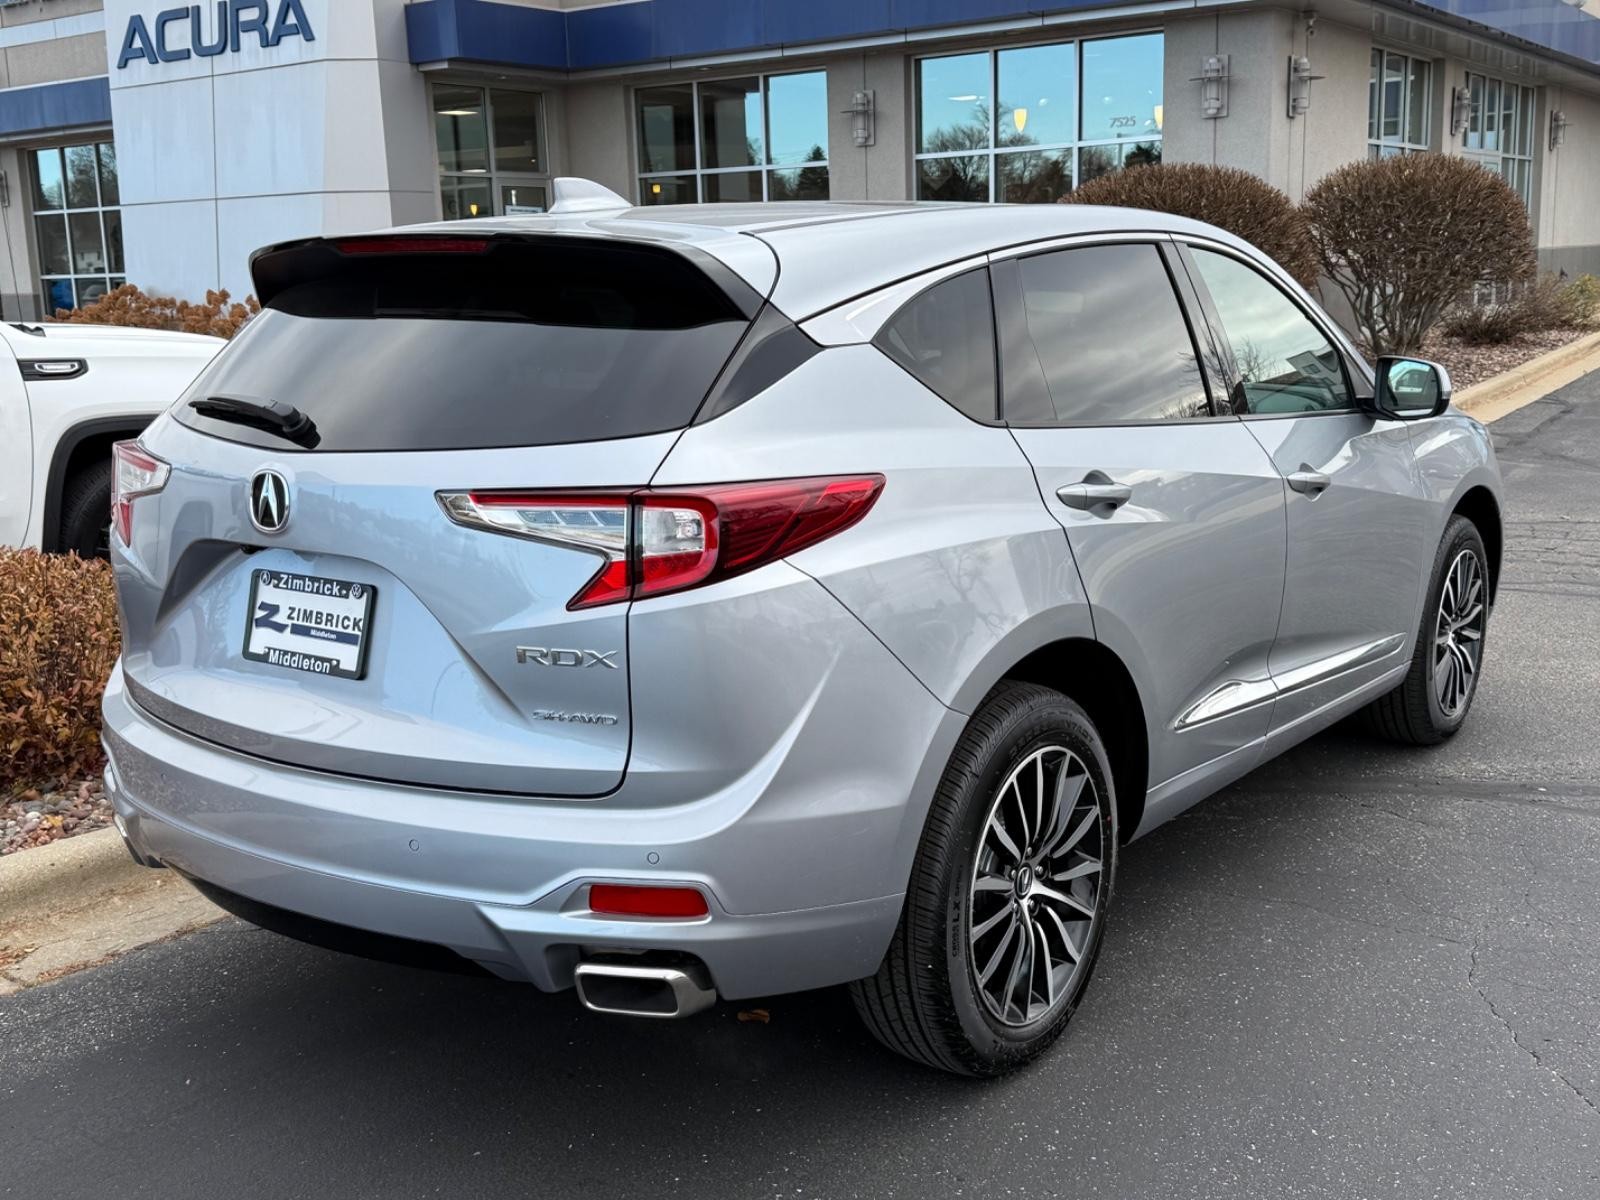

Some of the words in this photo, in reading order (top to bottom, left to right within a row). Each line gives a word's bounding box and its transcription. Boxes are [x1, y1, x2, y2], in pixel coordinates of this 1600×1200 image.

[117, 0, 315, 69] ACURA
[1109, 116, 1136, 128] 7525
[279, 574, 340, 597] Zimbrick
[286, 606, 364, 632] ZIMBRICK
[310, 629, 336, 640] Middleton
[268, 648, 331, 674] Middleton
[516, 645, 619, 669] RDX
[532, 709, 619, 726] SH-AWD
